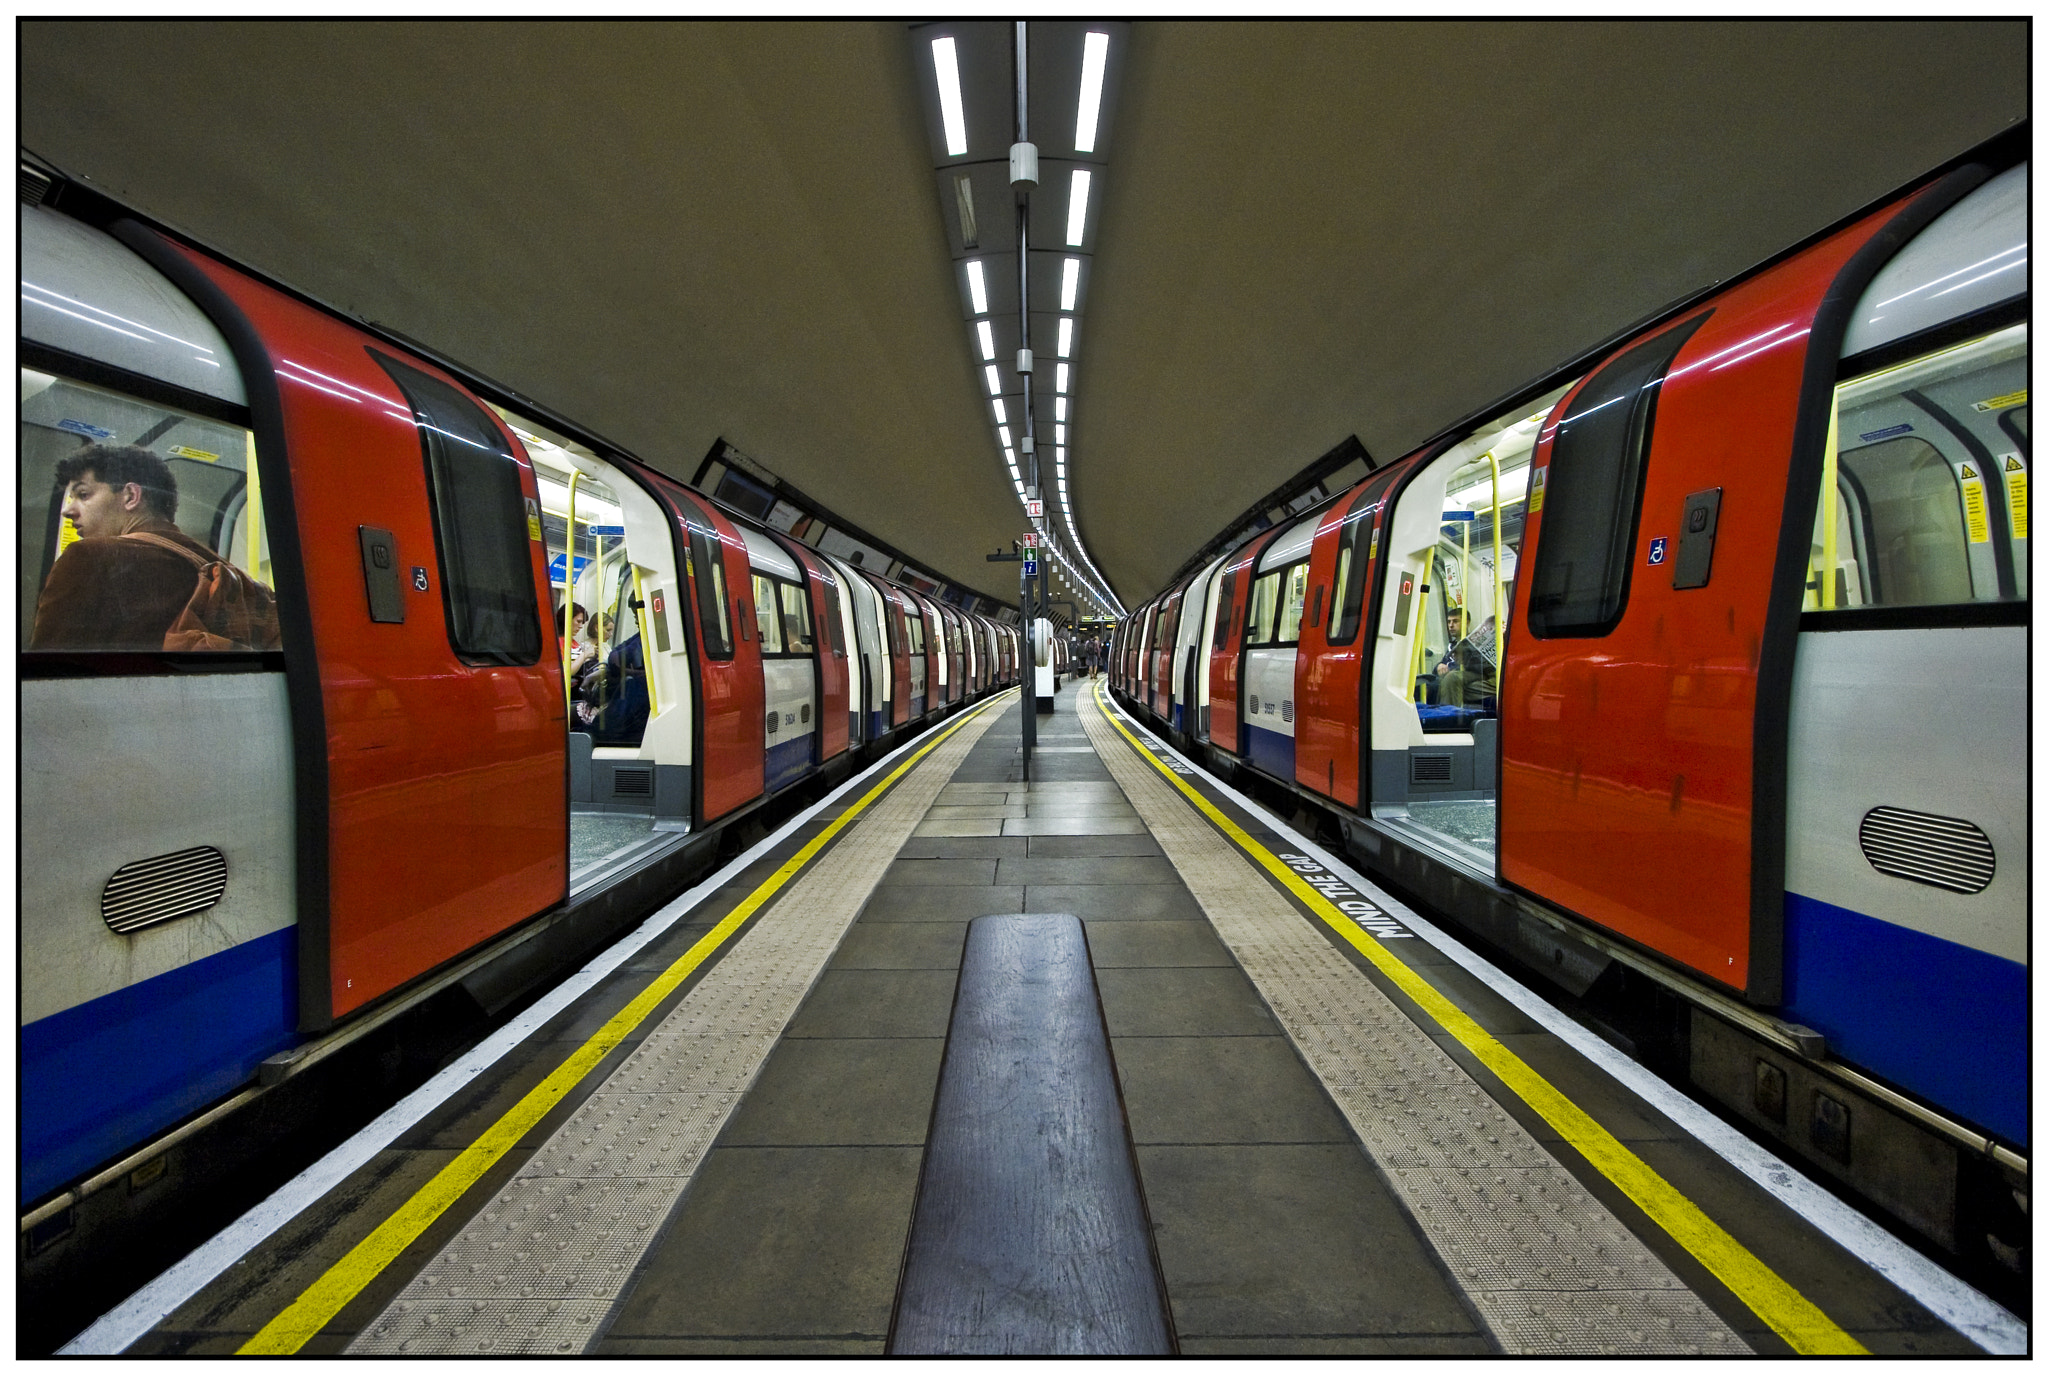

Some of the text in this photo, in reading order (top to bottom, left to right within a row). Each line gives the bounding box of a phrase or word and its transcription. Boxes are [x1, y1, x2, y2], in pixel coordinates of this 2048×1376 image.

[1278, 853, 1415, 938] MIND THE GAP
[347, 979, 352, 988] E
